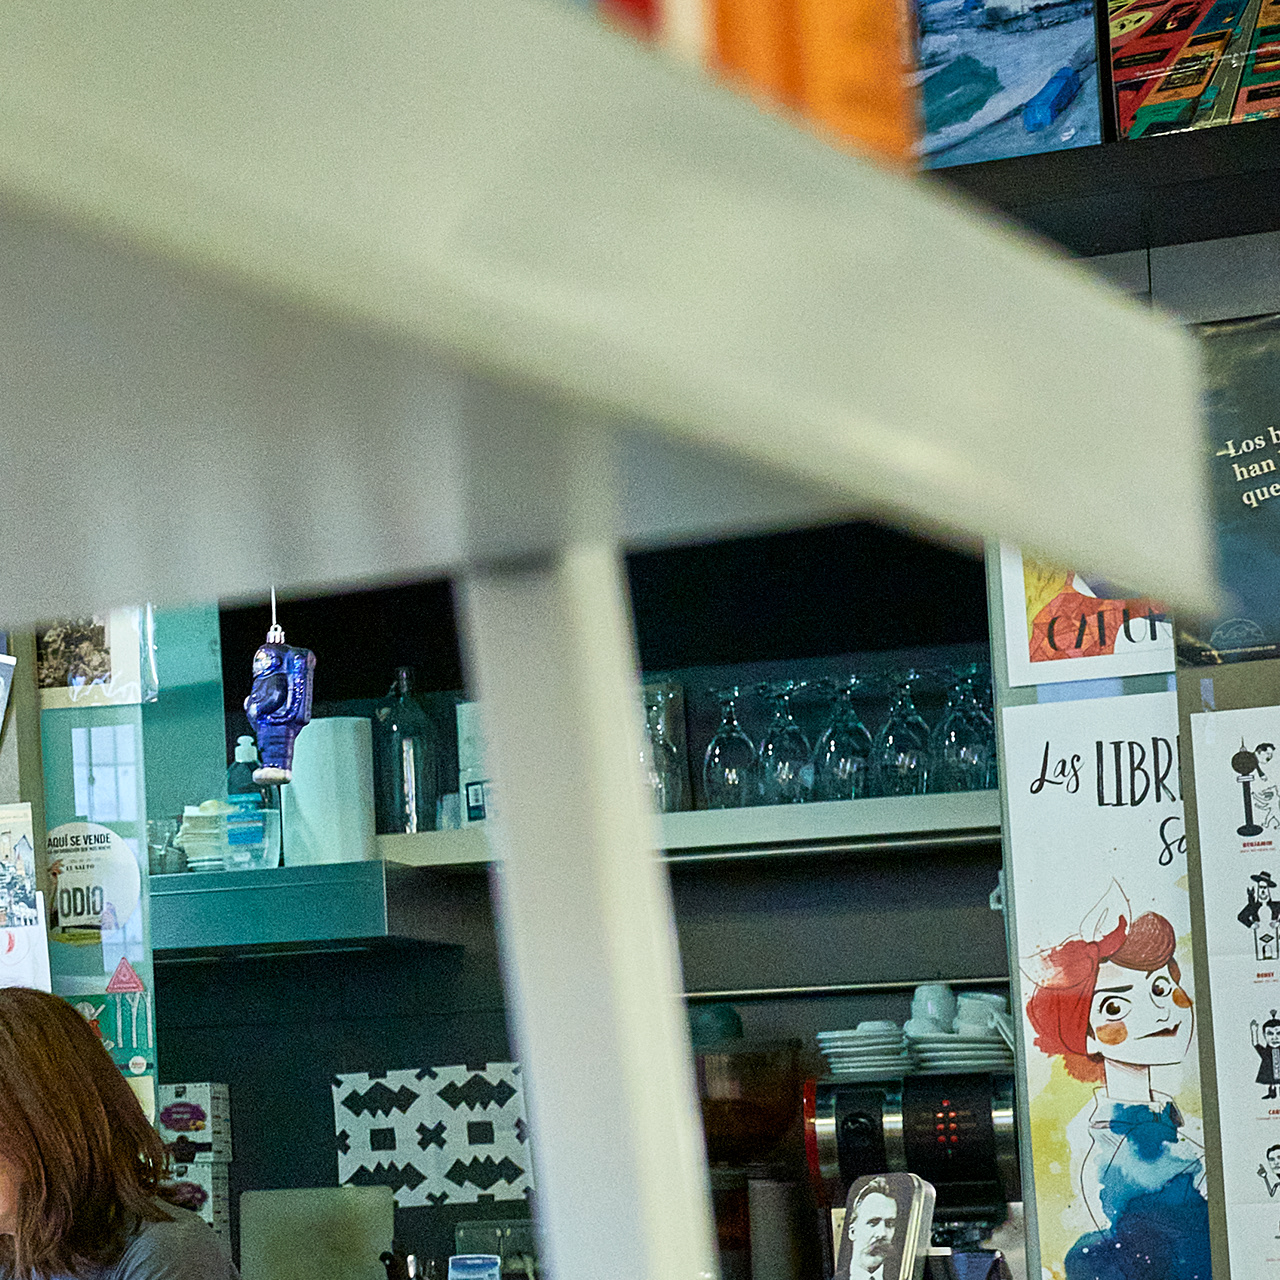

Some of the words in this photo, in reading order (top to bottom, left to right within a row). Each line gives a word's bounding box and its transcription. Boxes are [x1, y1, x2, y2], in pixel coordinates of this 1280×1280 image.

[1232, 459, 1276, 482] han
[1242, 482, 1280, 509] que
[1029, 740, 1085, 795] Las
[1096, 735, 1185, 807] LIBR
[47, 834, 69, 848] AQUÍ
[70, 835, 82, 847] SE
[83, 833, 112, 846] VENDE
[60, 885, 104, 918] ODIO
